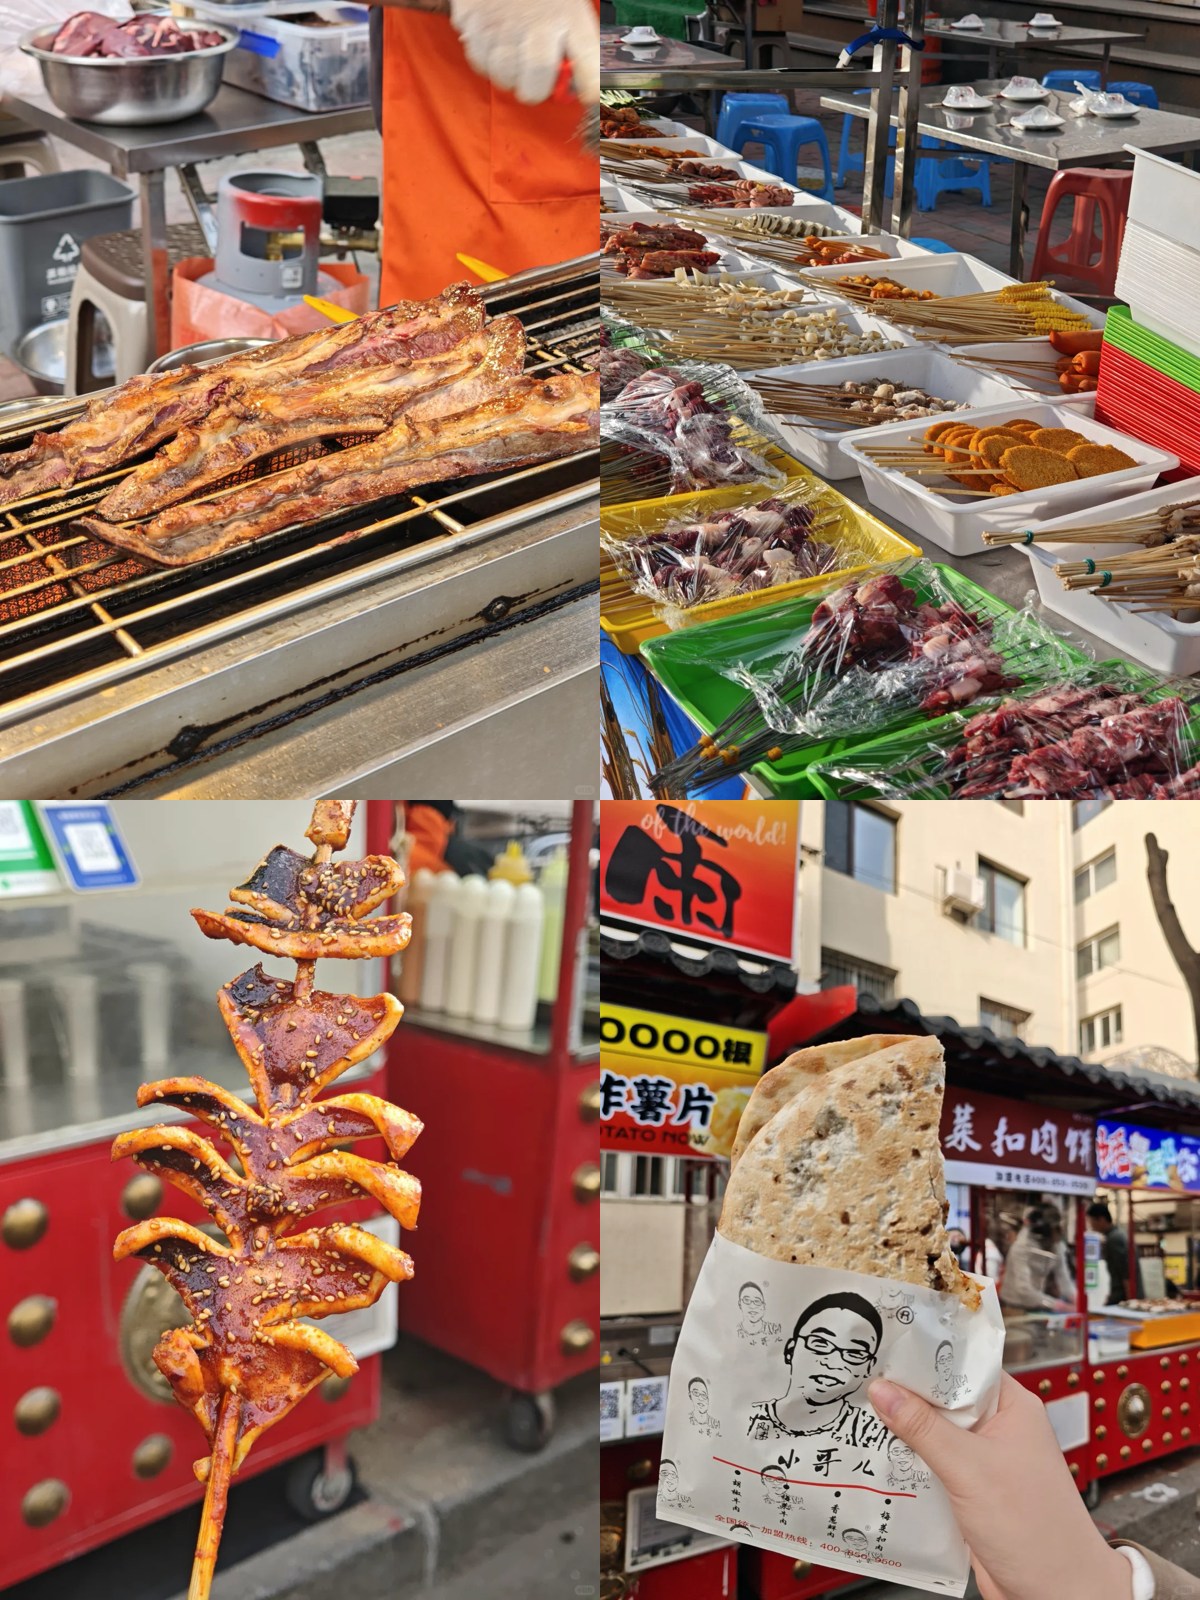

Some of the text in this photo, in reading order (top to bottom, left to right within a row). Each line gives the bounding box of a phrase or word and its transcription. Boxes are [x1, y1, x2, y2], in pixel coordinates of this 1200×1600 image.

[640, 801, 788, 846] of the world!
[600, 1125, 711, 1146] TATO NOW
[778, 1449, 876, 1477] 小哥儿
